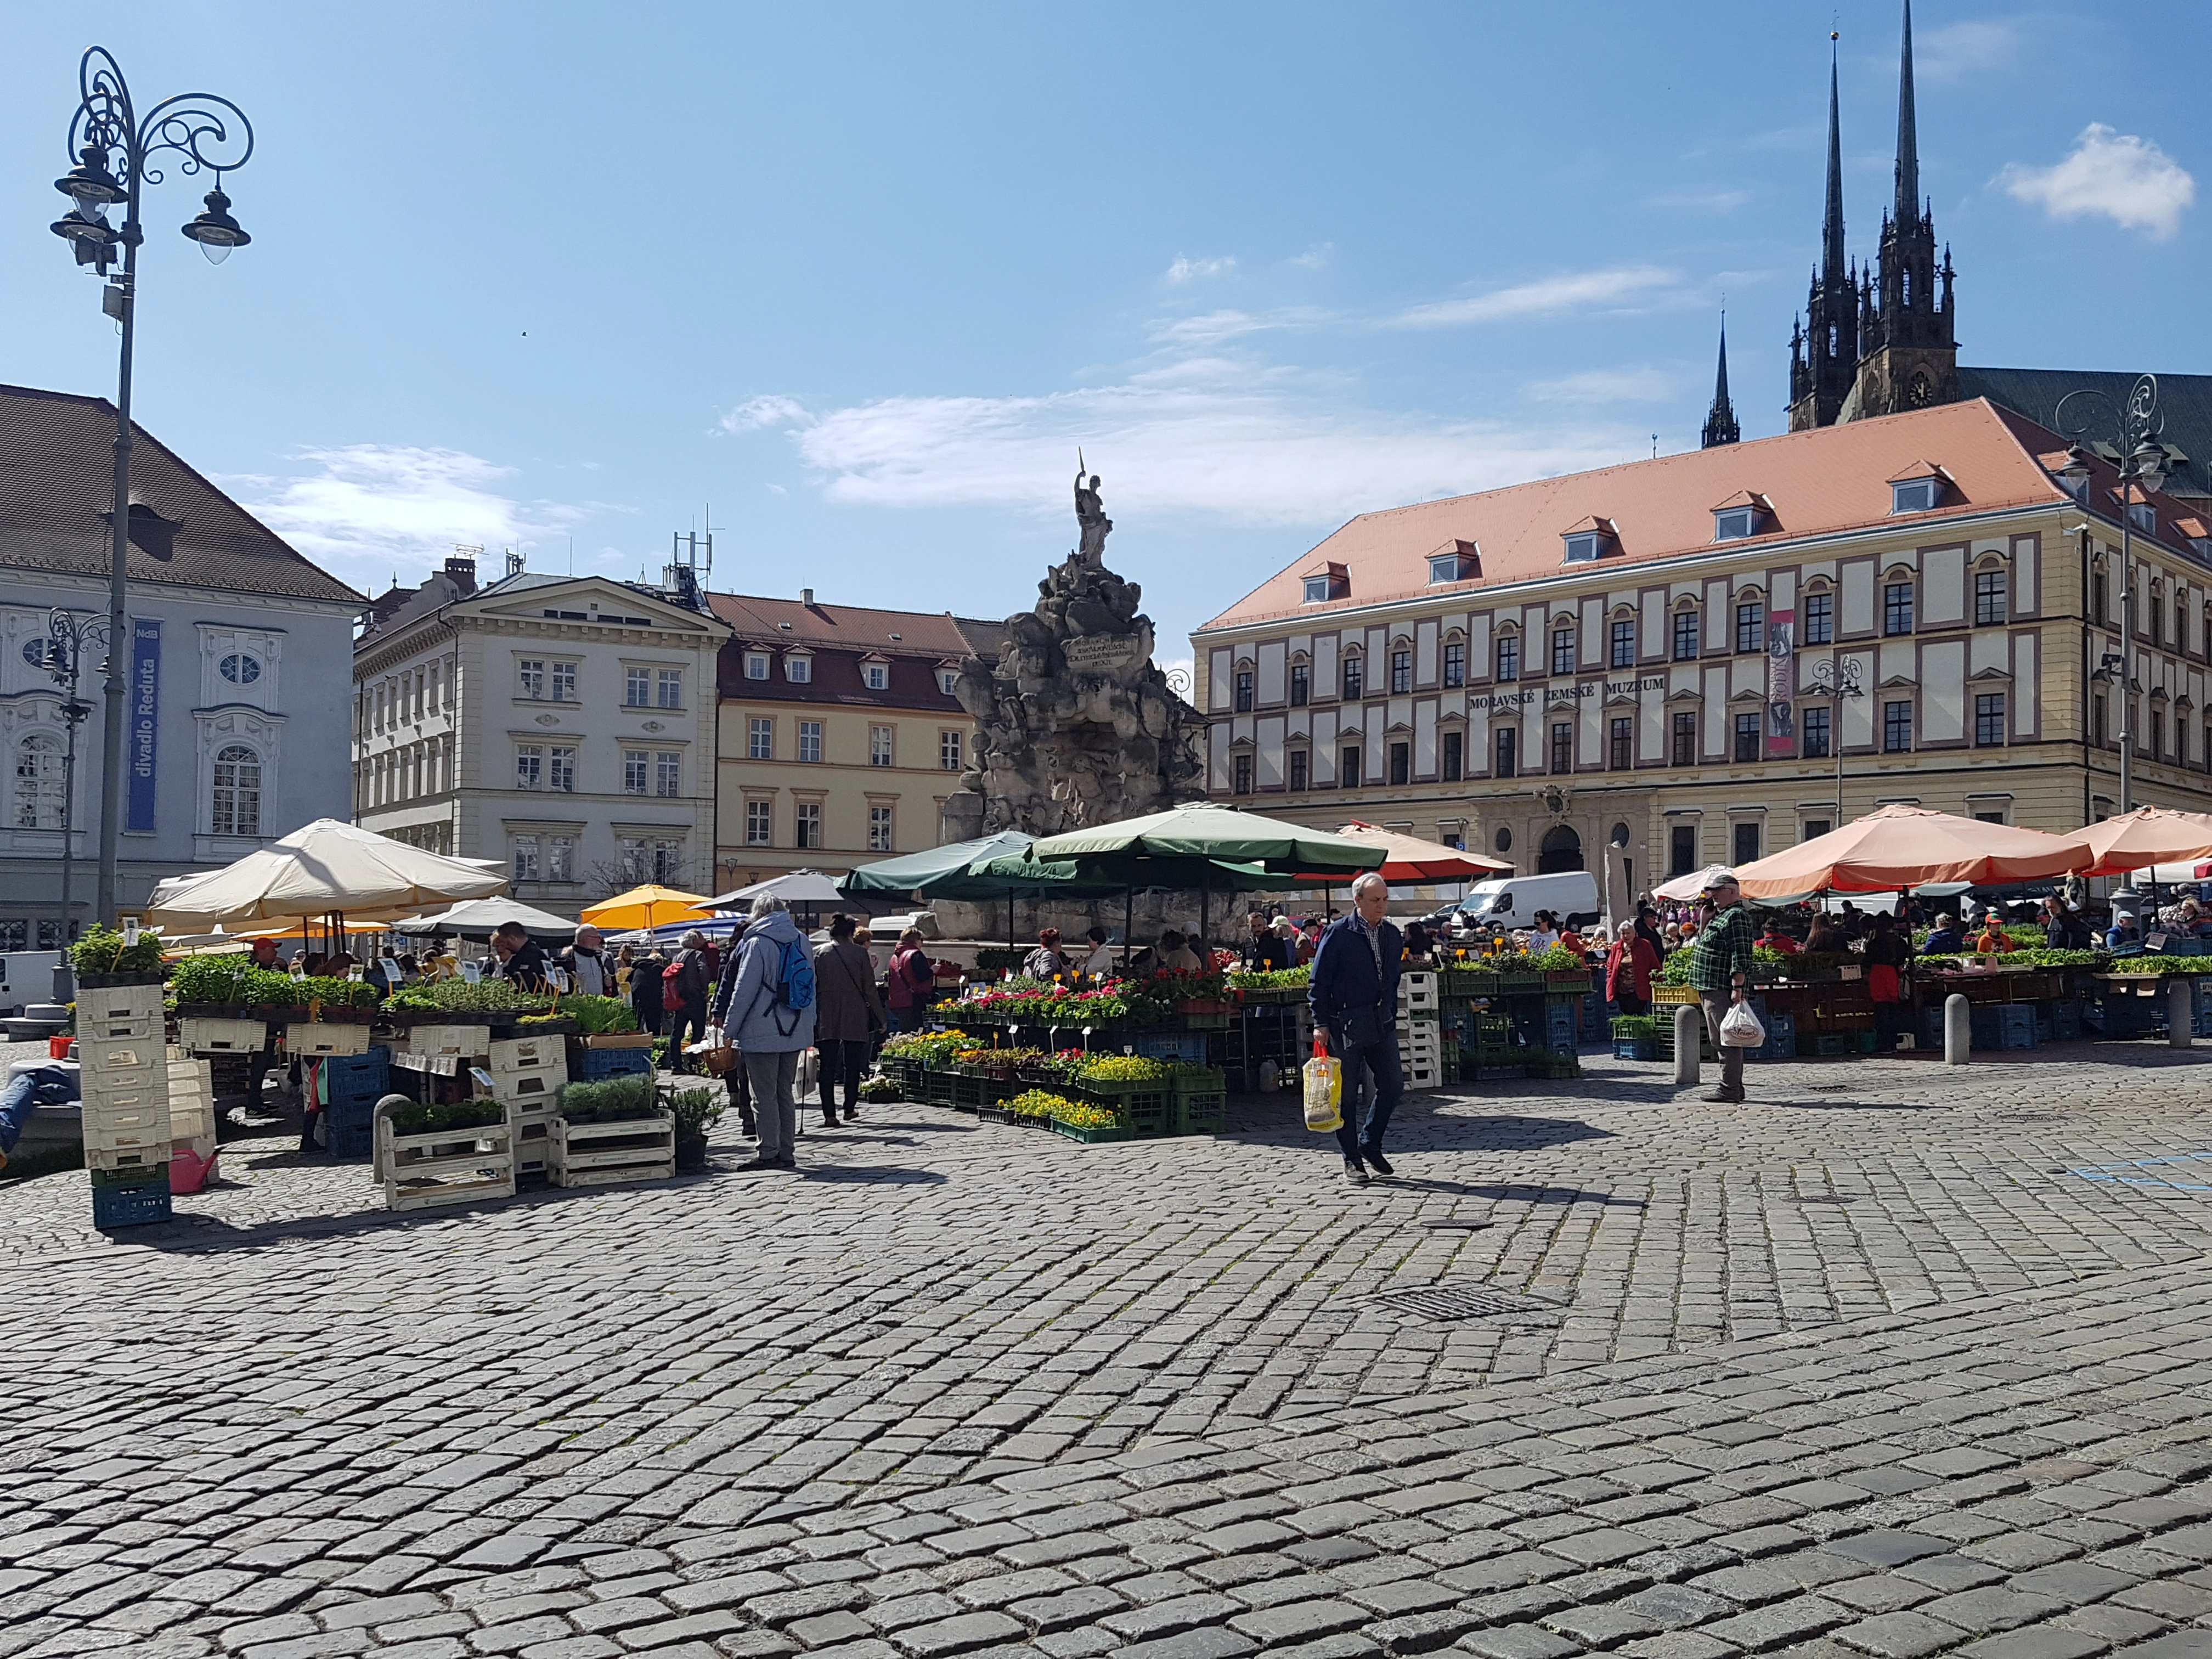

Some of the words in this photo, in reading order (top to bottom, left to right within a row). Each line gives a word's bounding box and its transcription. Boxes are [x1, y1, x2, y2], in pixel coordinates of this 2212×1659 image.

[136, 629, 158, 639] NdB
[138, 659, 155, 715] Reduta
[1470, 689, 1534, 709] MORAVSKÉ
[1544, 682, 1595, 701] ZEMSKÉ
[1606, 678, 1664, 695] MUZEUM
[1775, 658, 1787, 702] RODIN
[135, 720, 153, 777] divadlo
